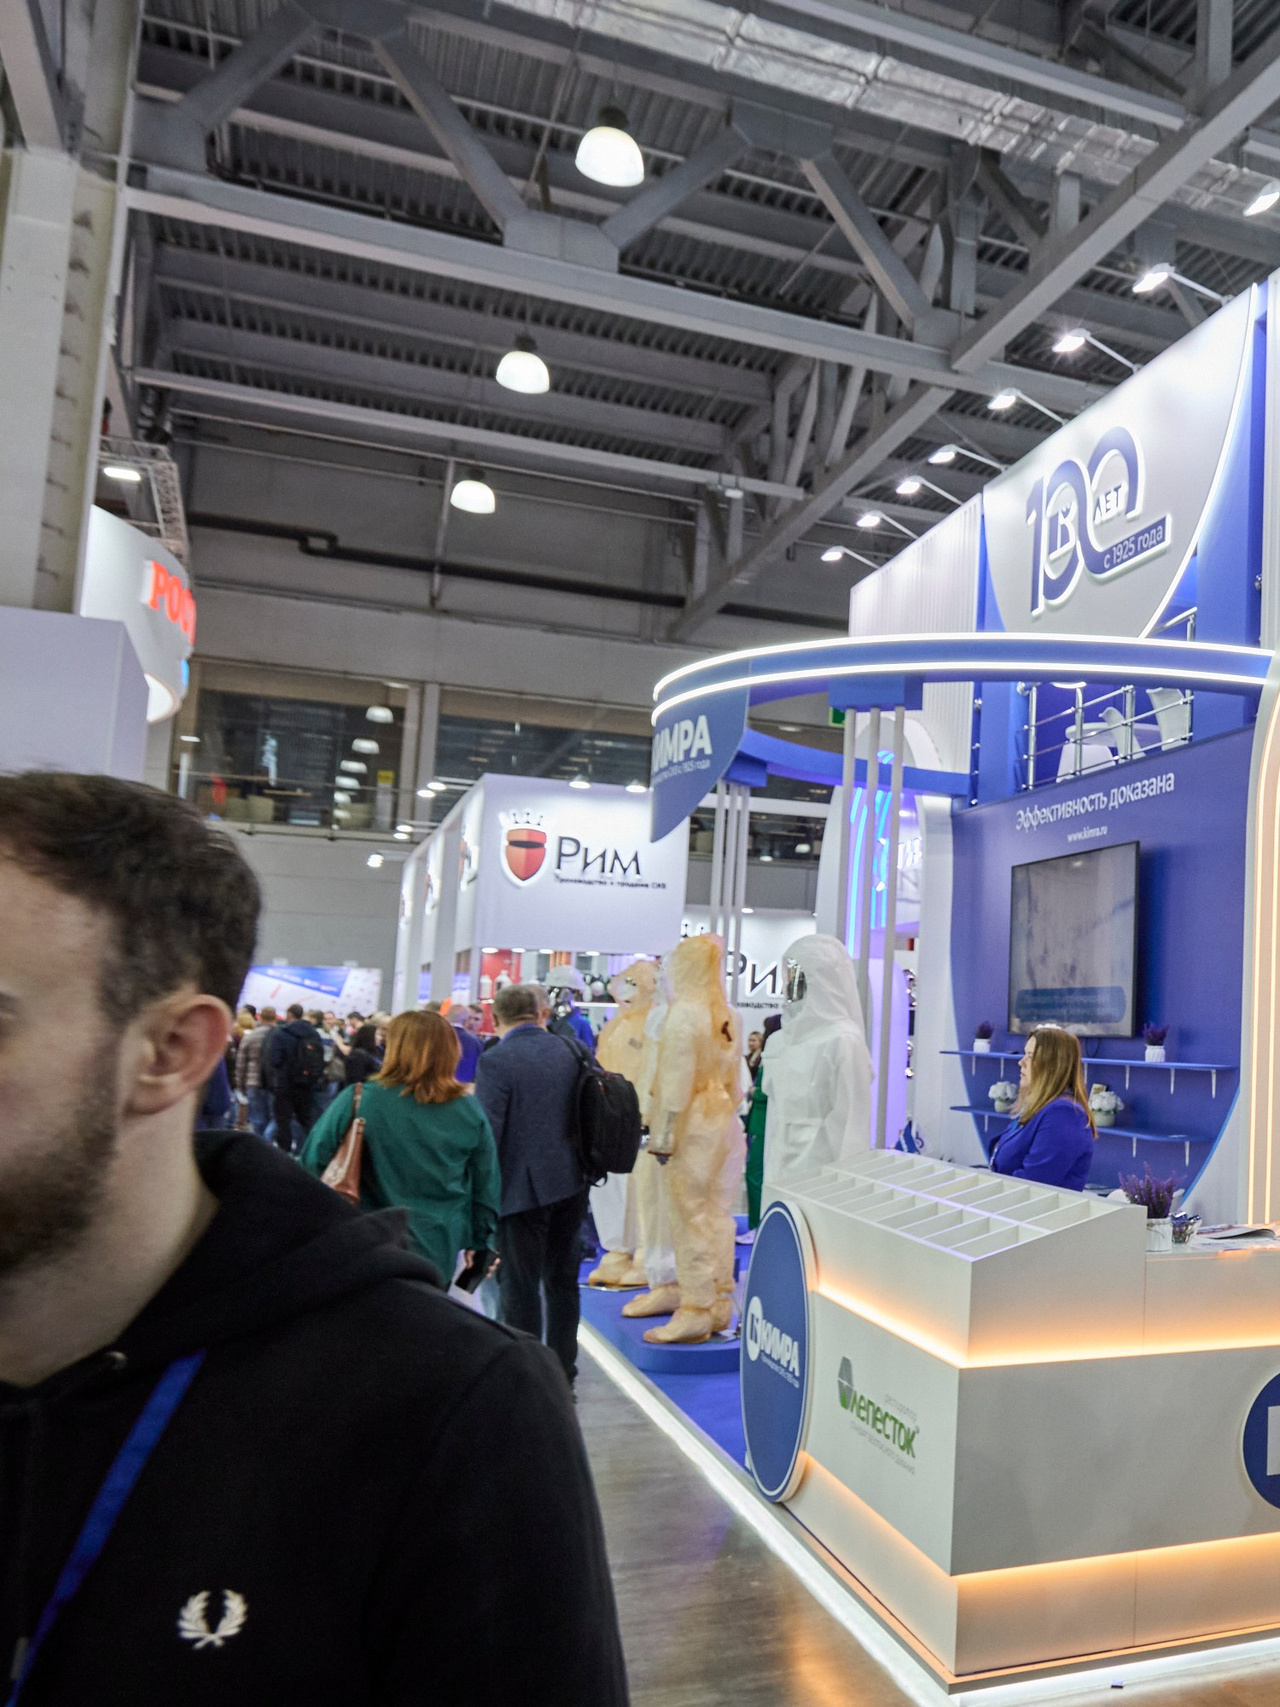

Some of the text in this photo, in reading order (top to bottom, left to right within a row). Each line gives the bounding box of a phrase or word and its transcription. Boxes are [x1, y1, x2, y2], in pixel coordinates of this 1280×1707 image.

[1112, 538, 1136, 565] 1925
[1137, 524, 1164, 554] года
[1016, 772, 1175, 833] Эффективность доказана
[1067, 825, 1108, 842] www.kimra.ru
[760, 1319, 800, 1377] КИМРА
